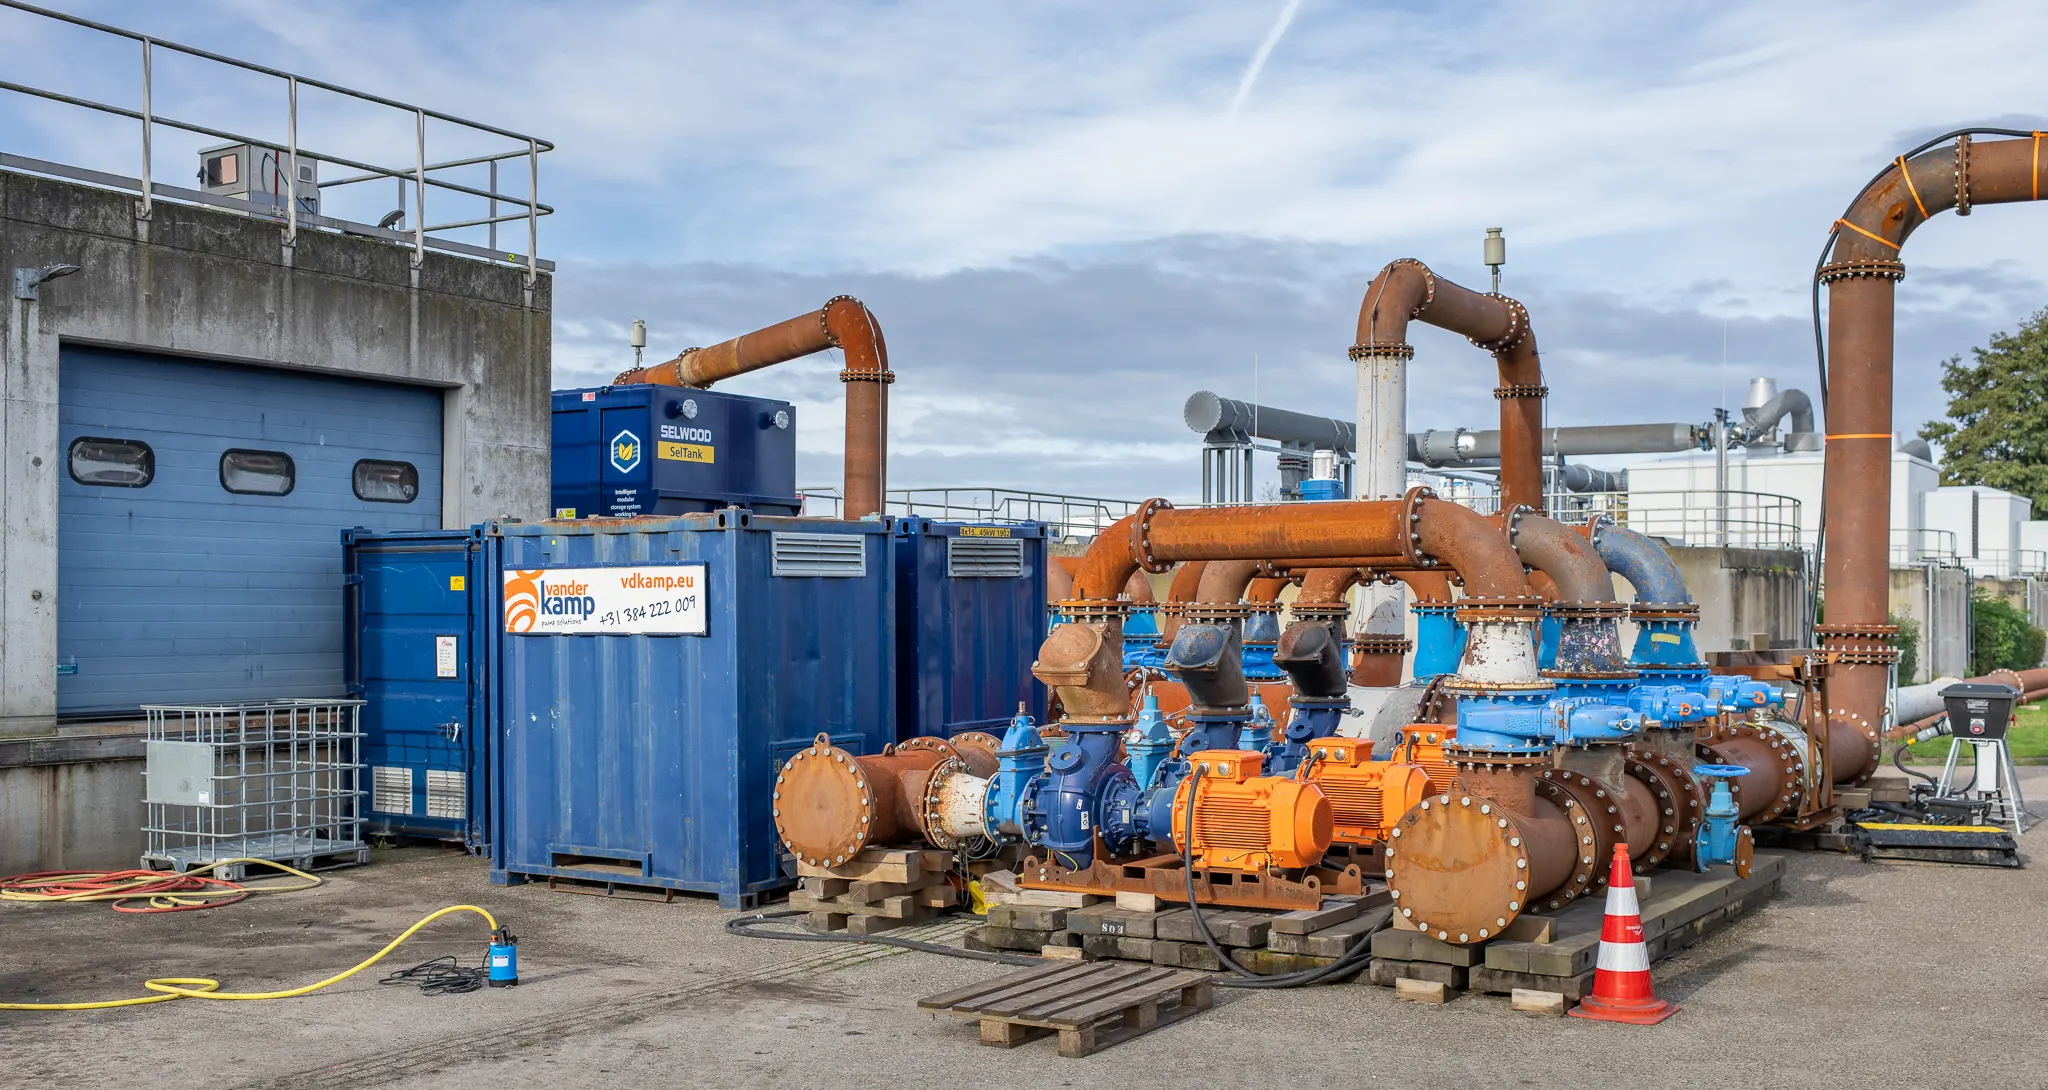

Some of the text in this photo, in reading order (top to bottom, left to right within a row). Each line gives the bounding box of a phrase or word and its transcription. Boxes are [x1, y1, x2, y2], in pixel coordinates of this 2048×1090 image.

[661, 424, 712, 443] SELWOOD
[670, 446, 703, 459] SelTank
[546, 580, 589, 596] vander
[621, 573, 694, 591] vdkamp.eu
[541, 580, 595, 621] kamp
[600, 595, 696, 626] +31 384 222 009
